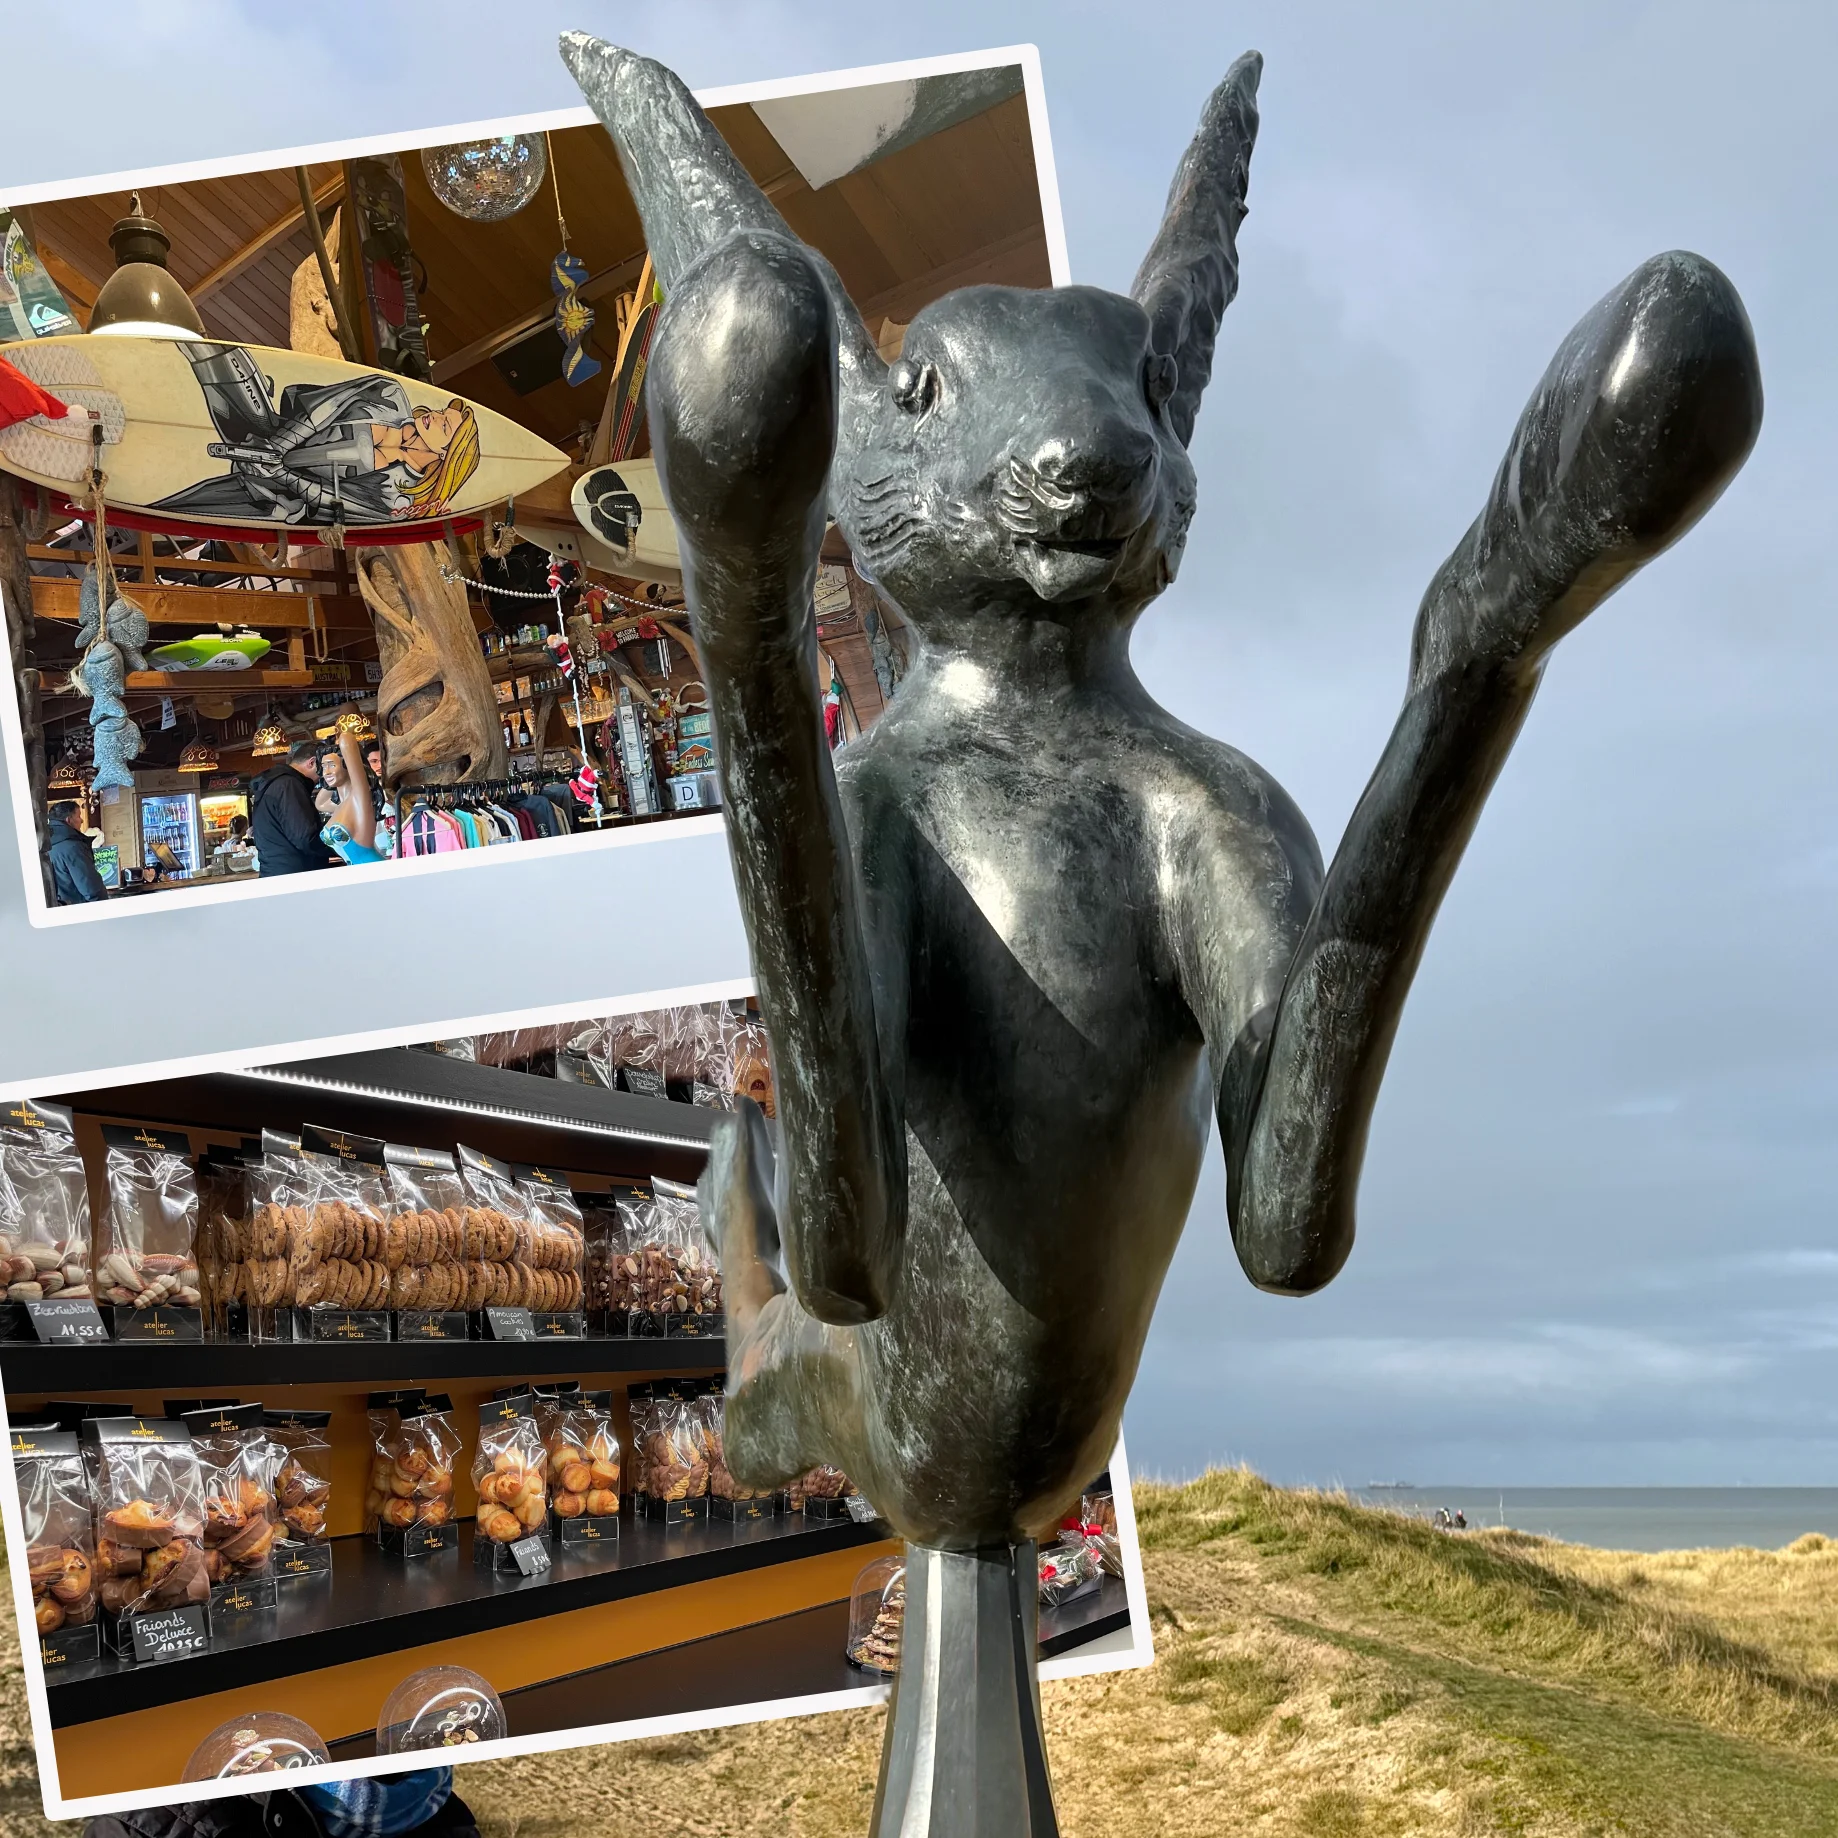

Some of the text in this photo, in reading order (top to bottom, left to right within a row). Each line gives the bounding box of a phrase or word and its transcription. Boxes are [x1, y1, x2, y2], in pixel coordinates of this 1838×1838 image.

[616, 627, 636, 638] WELCOME
[682, 786, 694, 801] D
[513, 1540, 540, 1558] Friands
[135, 1612, 186, 1635] Friands
[144, 1626, 196, 1647] Deluxe
